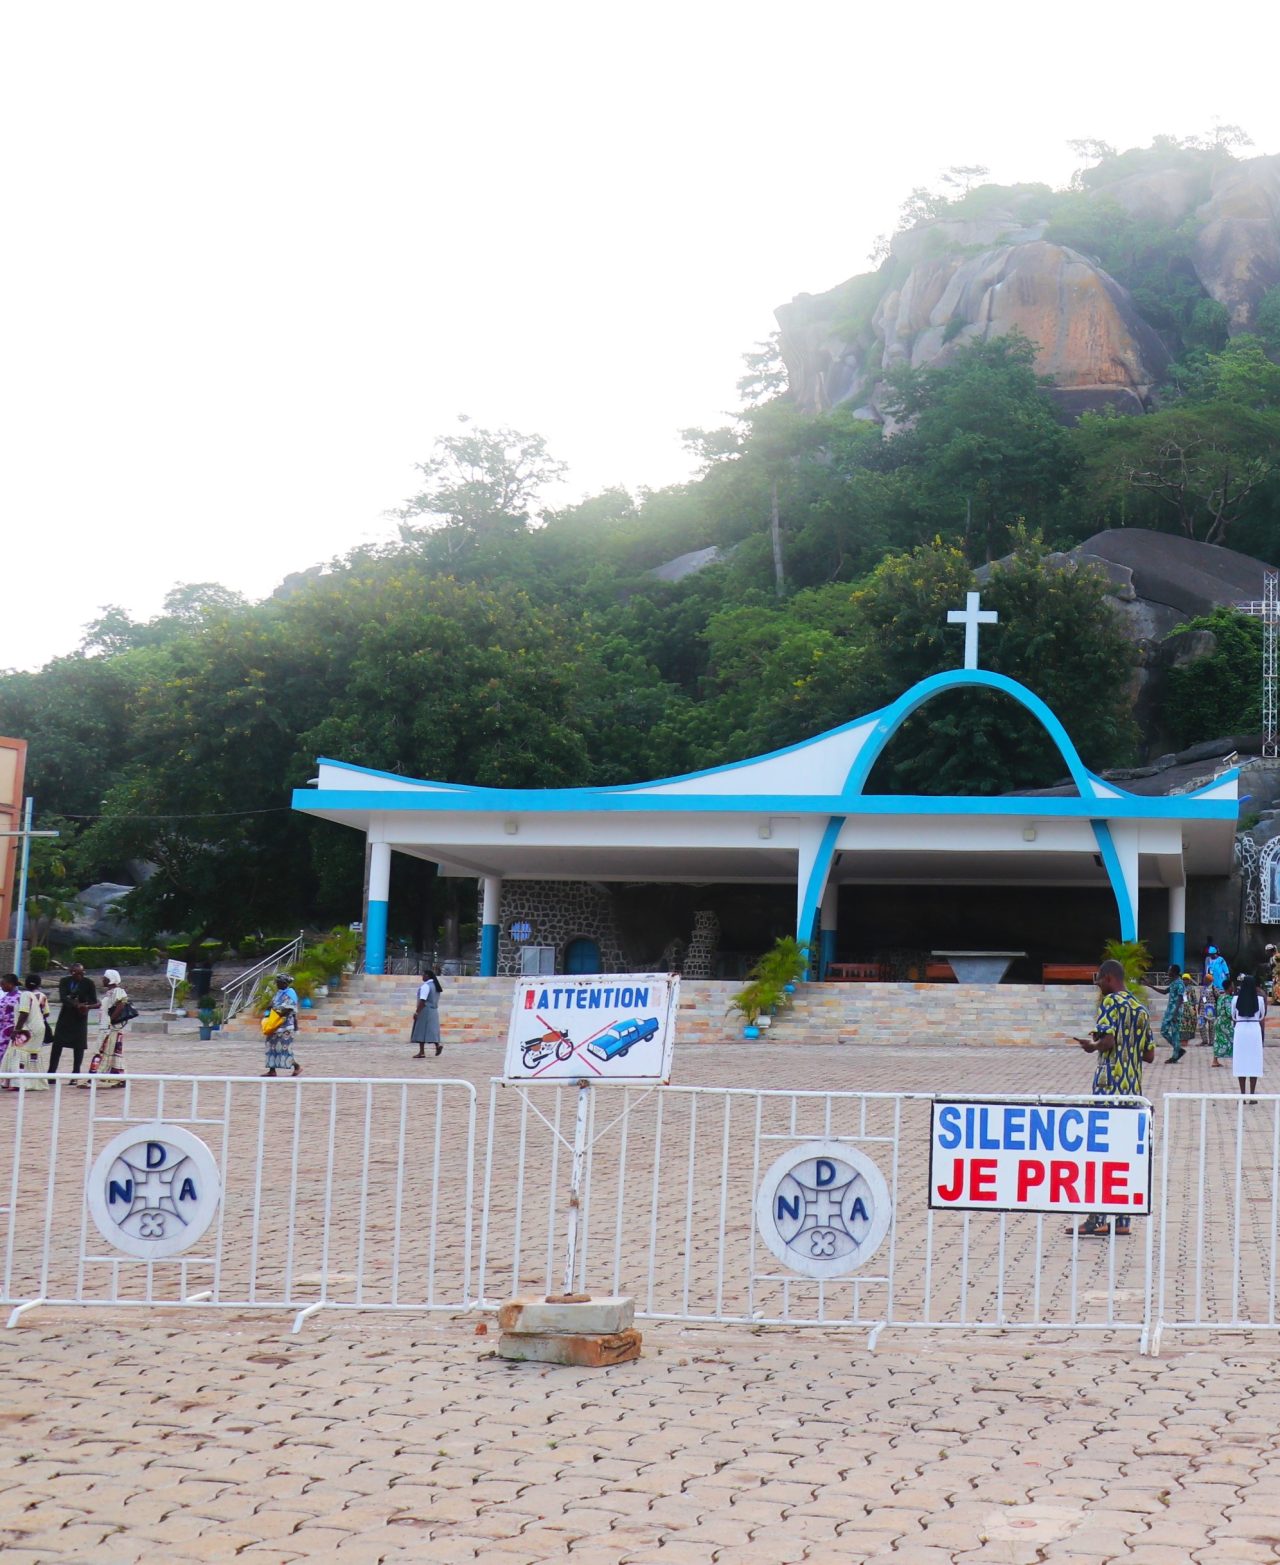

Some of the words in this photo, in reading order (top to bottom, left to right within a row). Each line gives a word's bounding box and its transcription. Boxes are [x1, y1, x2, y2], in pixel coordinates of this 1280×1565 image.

[537, 988, 649, 1010] ATTENTION
[938, 1106, 1109, 1152] SILENCE
[937, 1158, 998, 1201] JE
[1017, 1159, 1144, 1205] PRIE.
